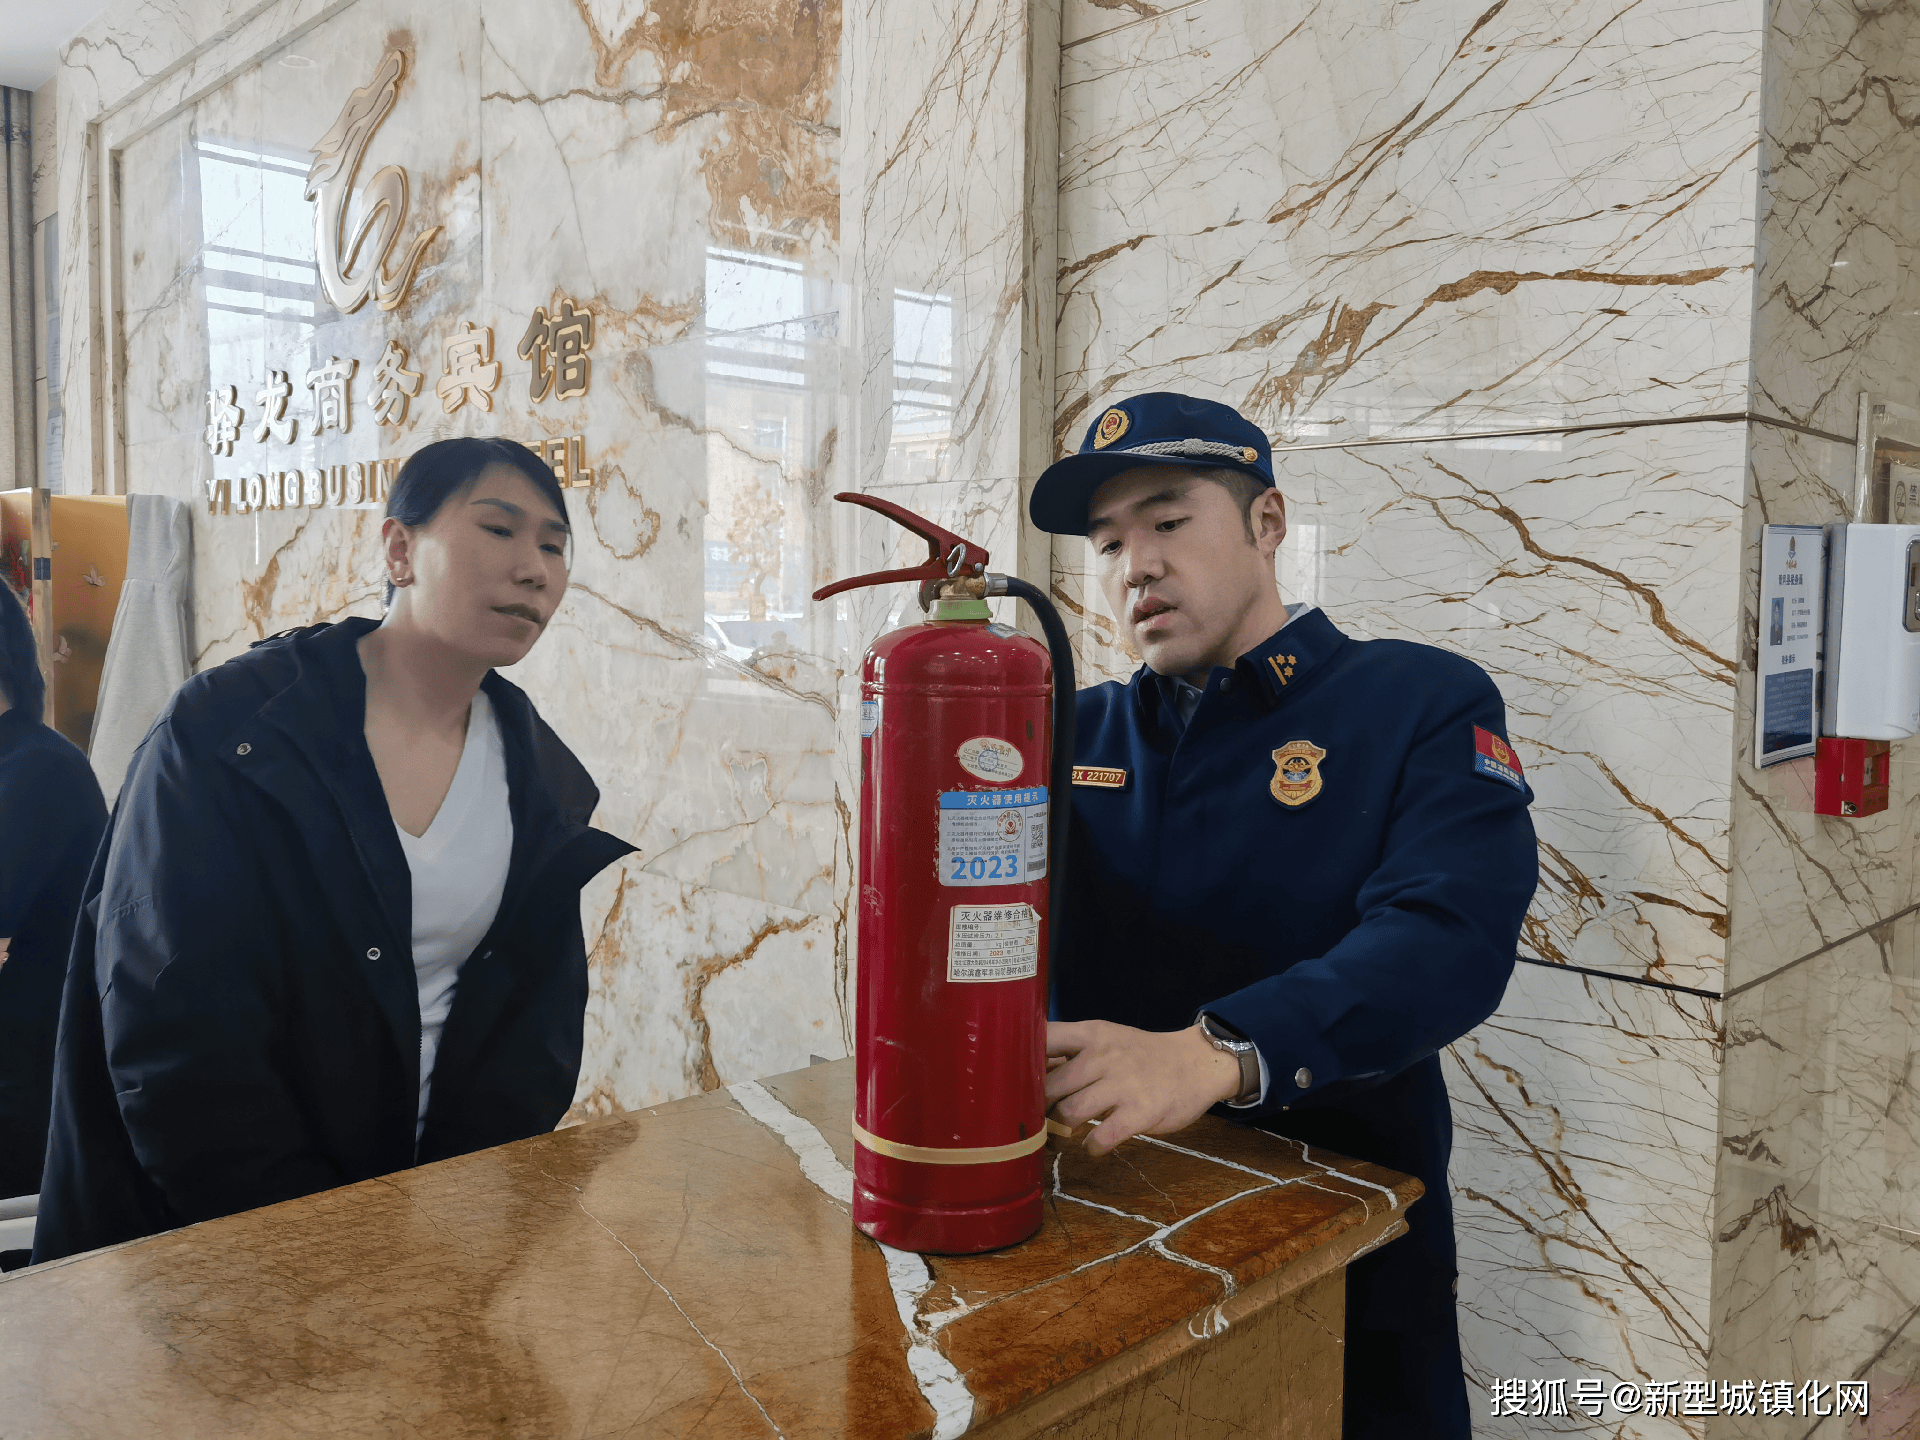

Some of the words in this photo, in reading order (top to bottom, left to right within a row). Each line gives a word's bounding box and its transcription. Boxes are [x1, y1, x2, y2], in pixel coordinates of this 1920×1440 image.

[205, 479, 231, 515] YI
[236, 468, 302, 514] LONG
[1086, 771, 1122, 782] 221707
[966, 791, 1039, 806] 灭火器使用提示
[951, 854, 1018, 880] 2023
